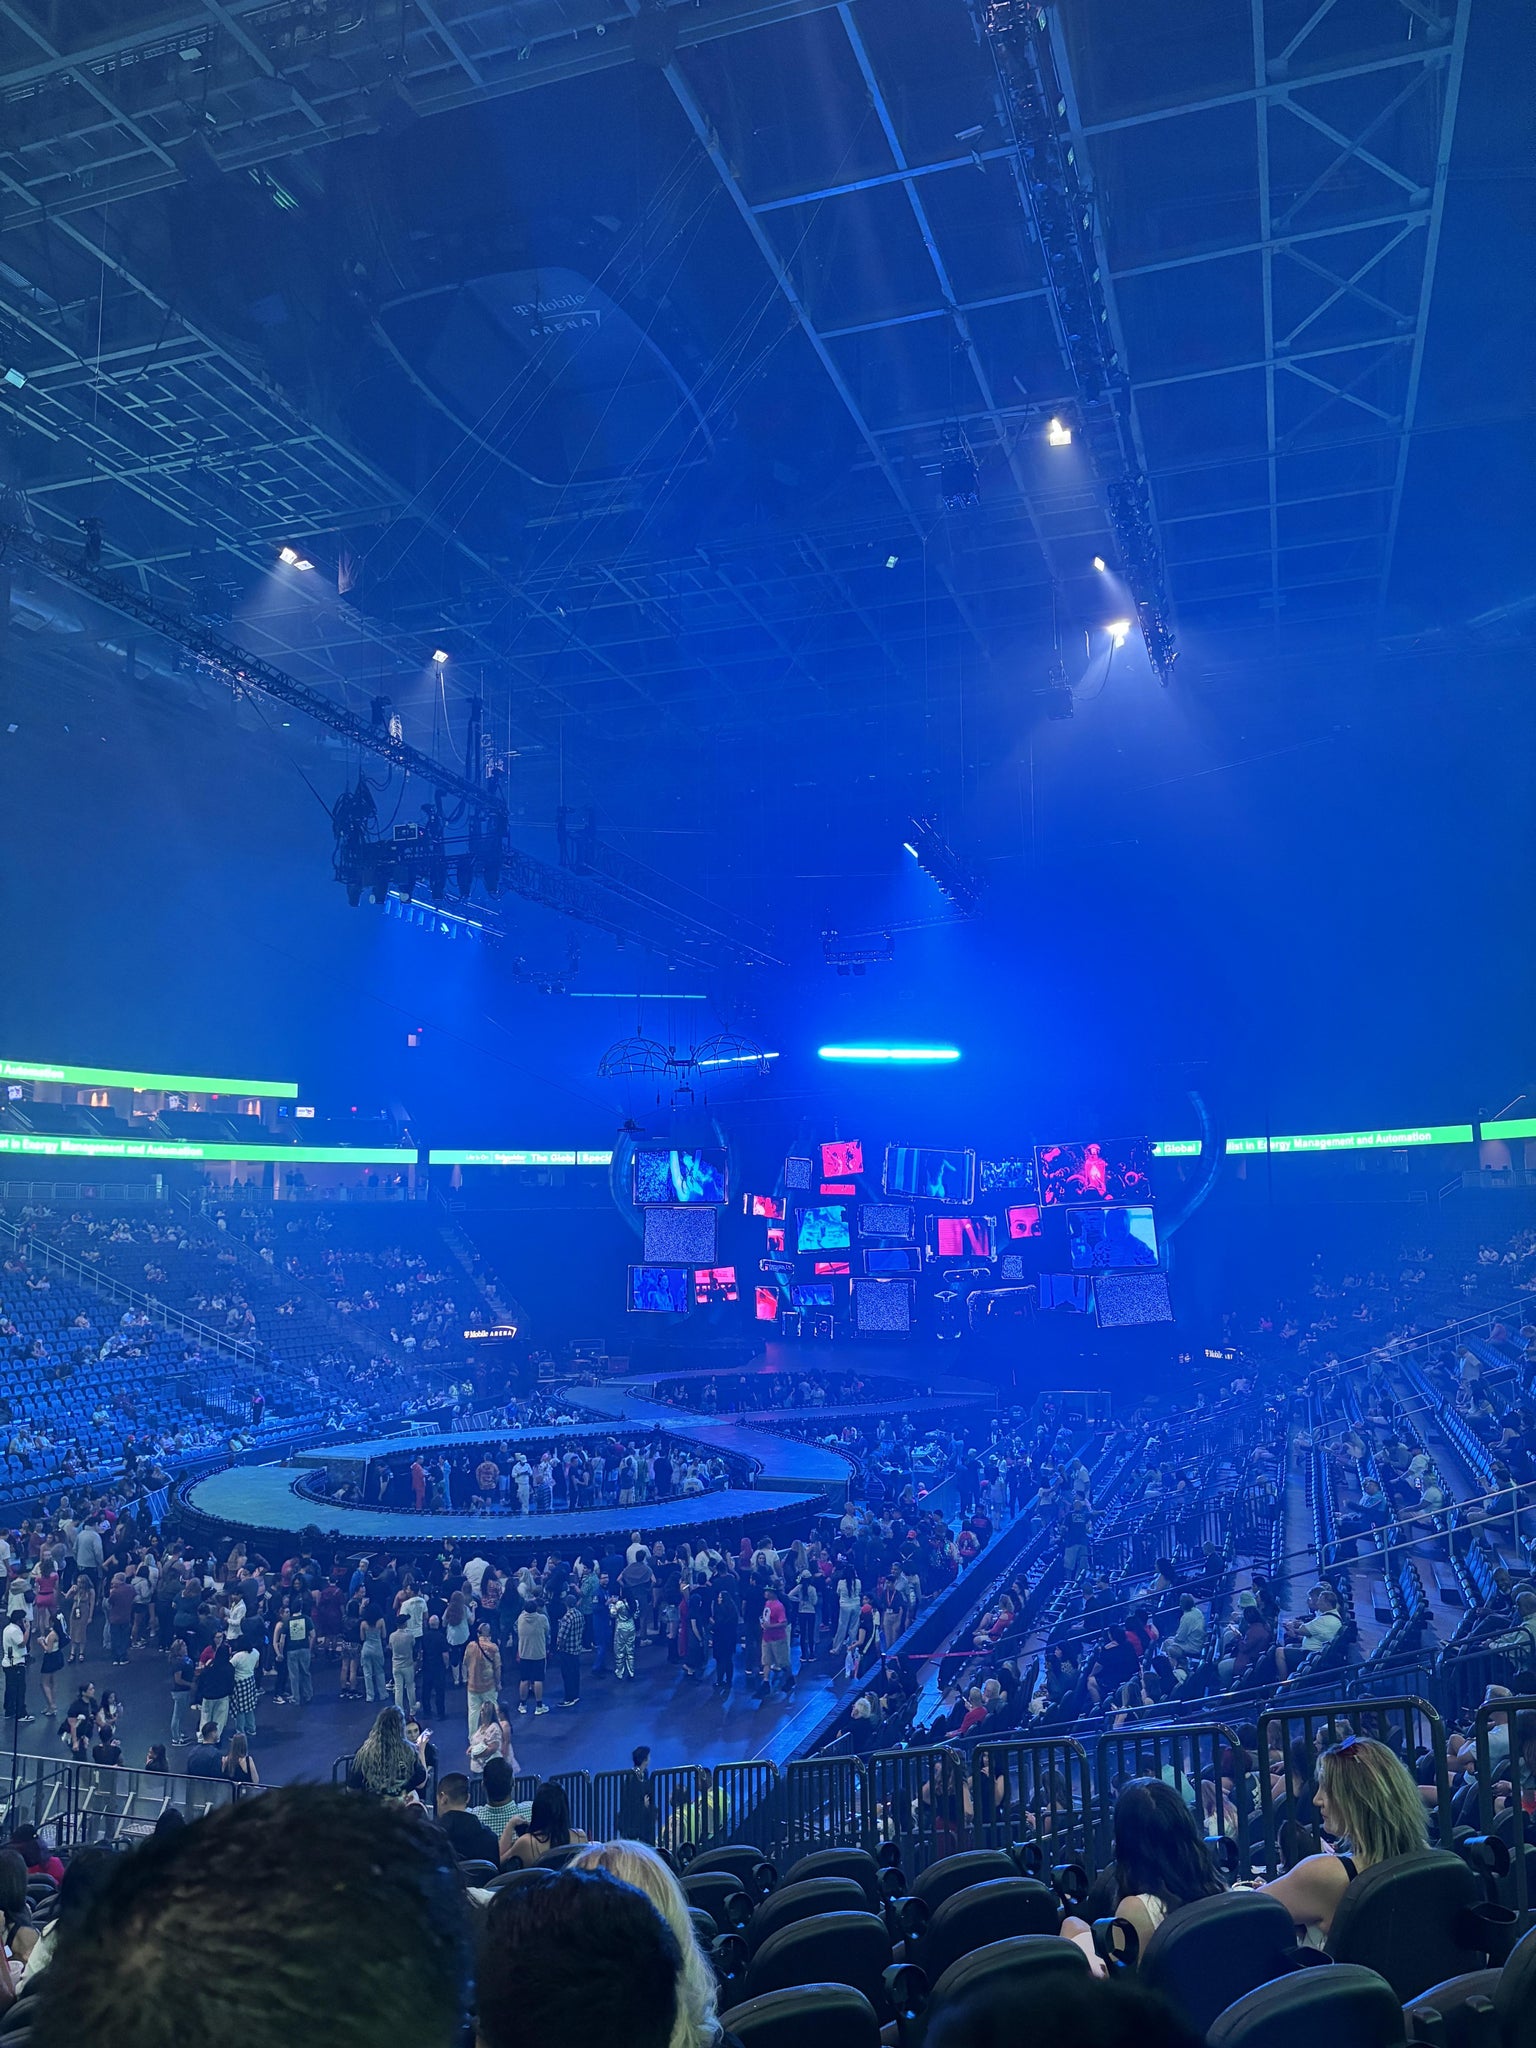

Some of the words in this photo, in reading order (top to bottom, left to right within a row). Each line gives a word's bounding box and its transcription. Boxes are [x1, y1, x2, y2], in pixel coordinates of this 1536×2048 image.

[530, 318, 592, 337] ARENA
[4, 1063, 65, 1079] Automation
[22, 1138, 58, 1154] Energy
[61, 1140, 125, 1156] Management
[127, 1143, 145, 1154] and
[146, 1144, 204, 1156] Automation
[1164, 1143, 1196, 1153] Global
[1246, 1140, 1255, 1150] in
[1294, 1136, 1354, 1150] Management
[1357, 1135, 1374, 1145] and
[1376, 1131, 1432, 1144] Automation
[531, 1153, 548, 1162] The
